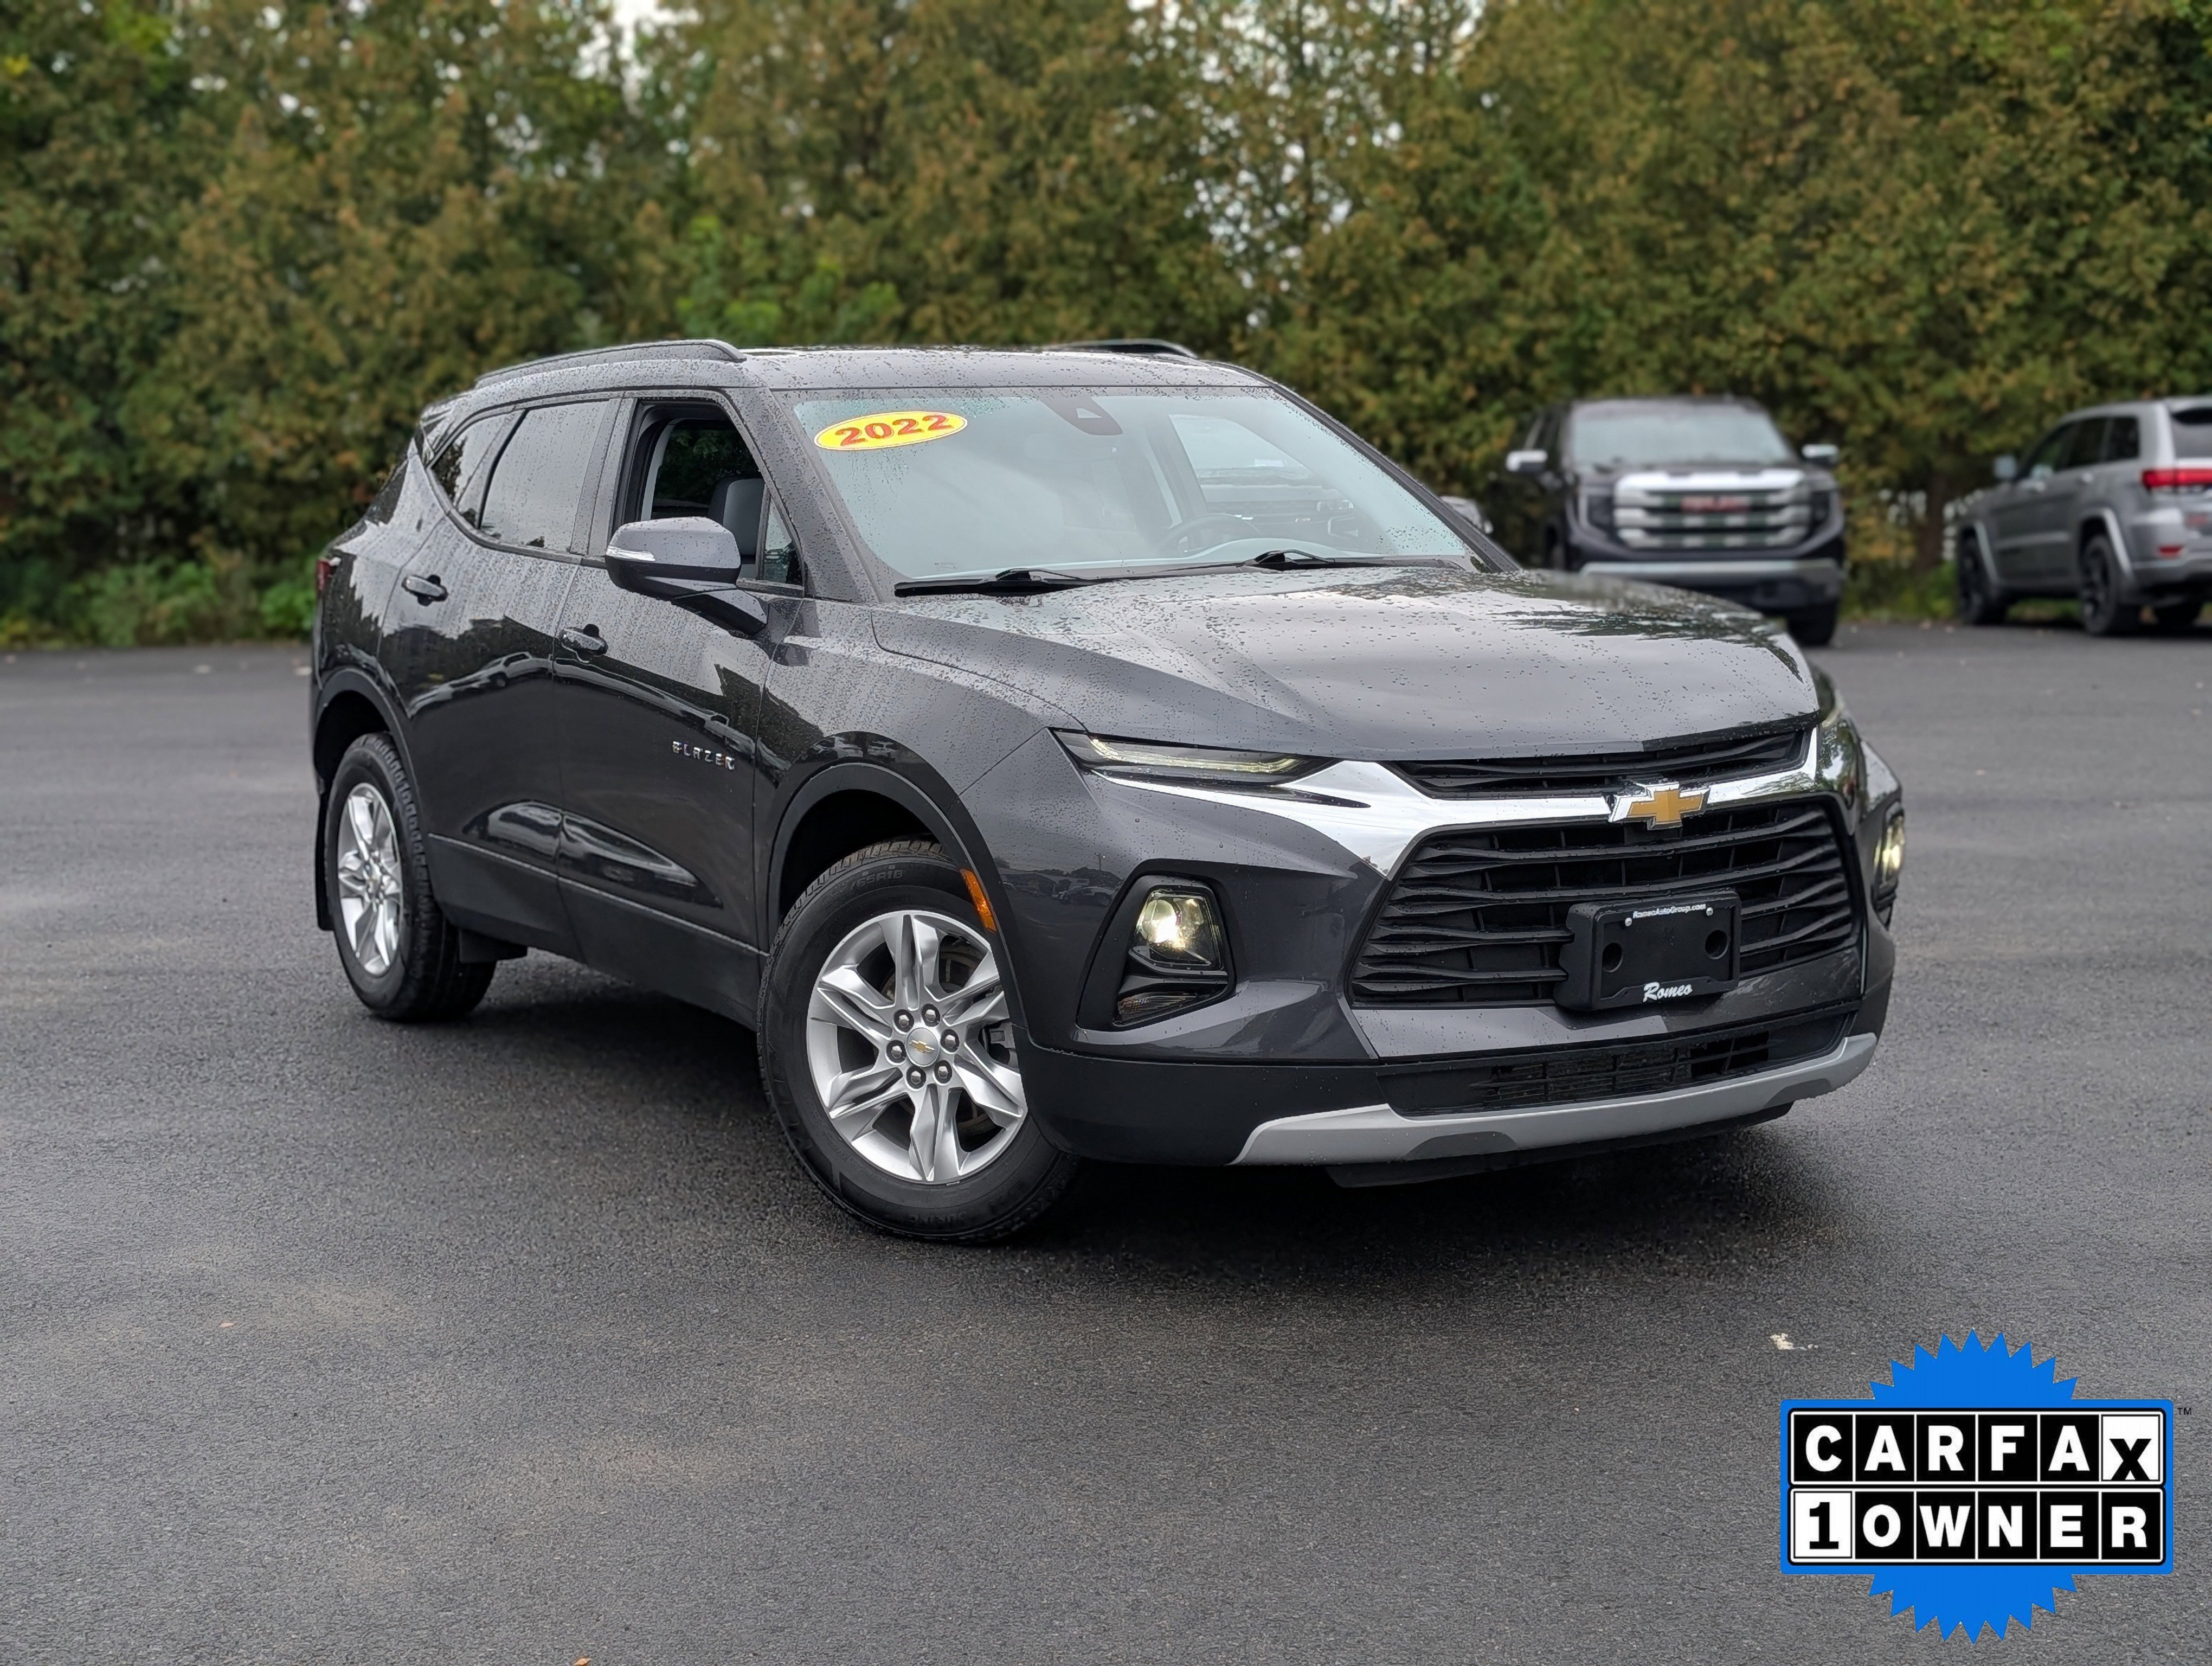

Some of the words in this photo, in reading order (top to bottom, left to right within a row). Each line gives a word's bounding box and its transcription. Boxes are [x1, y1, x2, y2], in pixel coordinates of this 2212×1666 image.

[835, 415, 954, 446] 2022
[672, 741, 735, 770] BLAZER
[1643, 982, 1693, 1002] Romeo
